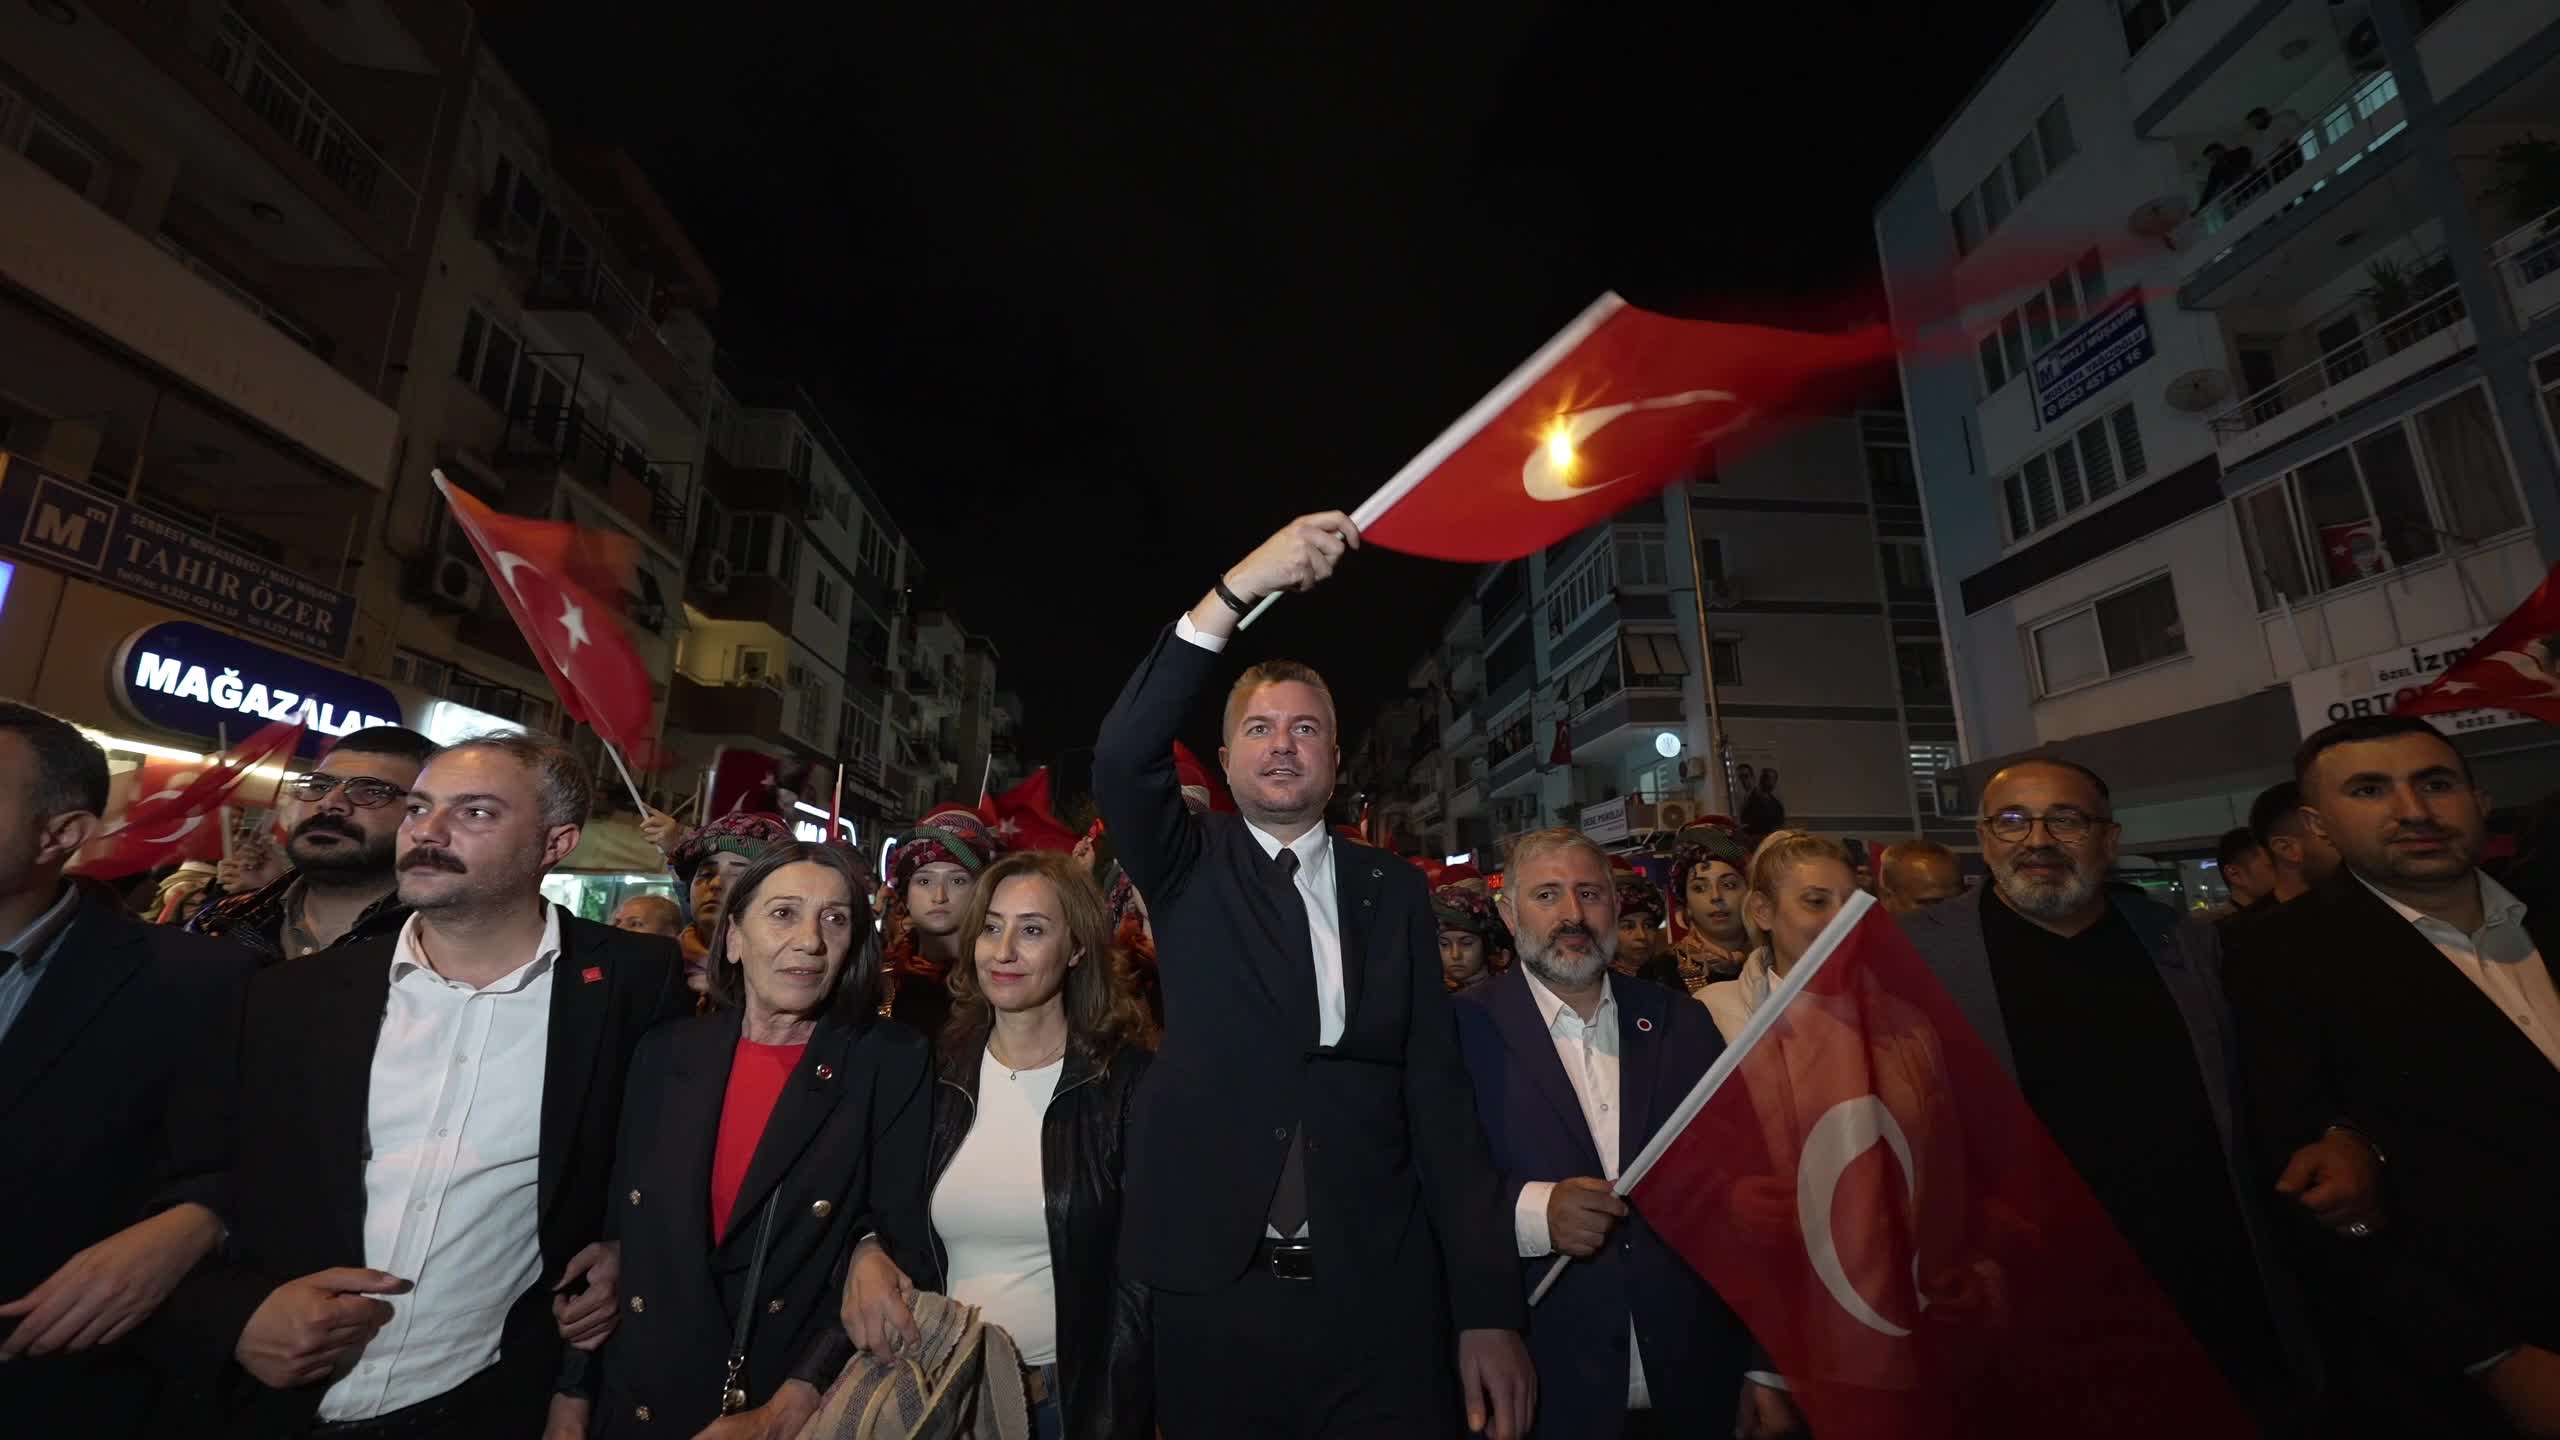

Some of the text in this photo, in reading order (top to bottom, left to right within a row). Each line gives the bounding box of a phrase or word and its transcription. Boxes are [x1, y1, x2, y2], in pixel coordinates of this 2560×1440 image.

[124, 532, 336, 634] TAHİR ÖZER
[135, 652, 398, 737] MAĞAZALA
[2378, 667, 2412, 682] ÖZEL
